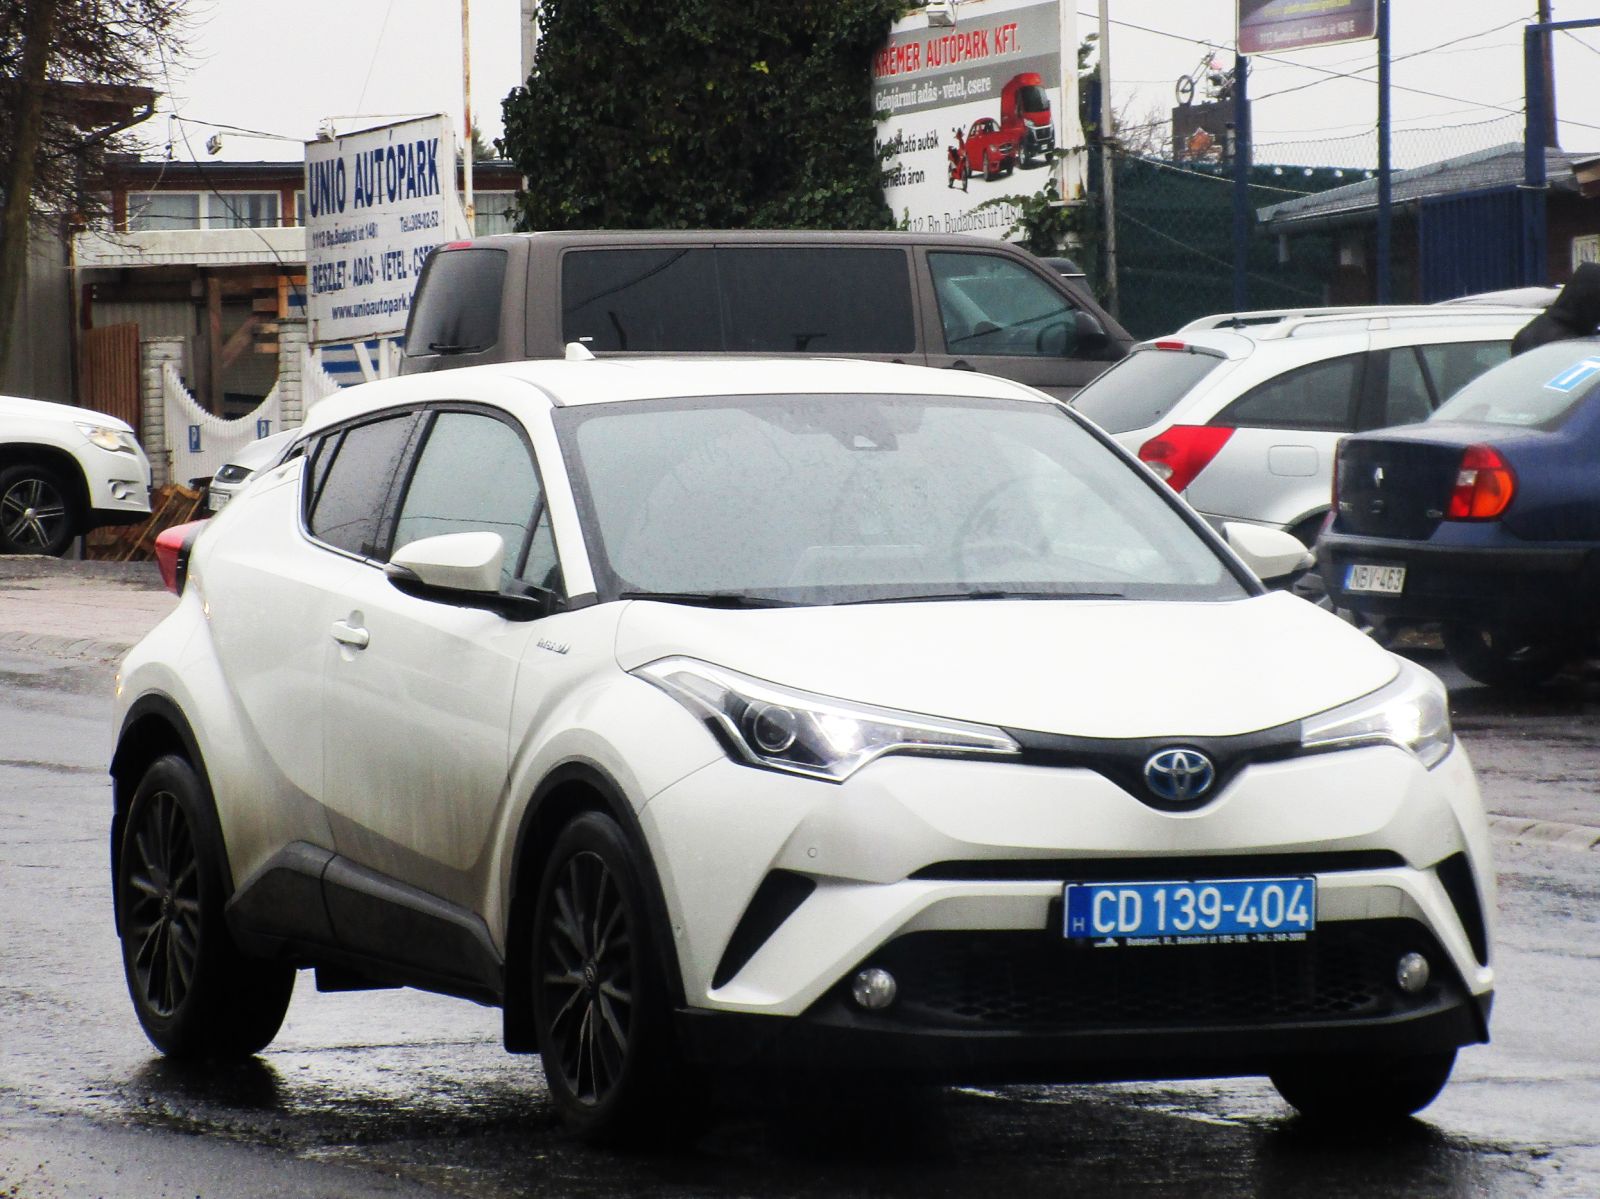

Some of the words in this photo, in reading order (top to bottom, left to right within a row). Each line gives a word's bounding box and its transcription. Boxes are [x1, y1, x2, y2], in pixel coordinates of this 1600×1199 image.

[875, 37, 920, 80] KRÉMER
[926, 29, 990, 67] AUTÓPARK
[995, 23, 1022, 56] KFT.
[875, 85, 917, 114] Gépjármű
[918, 84, 938, 104] adás
[968, 77, 991, 95] csere
[918, 129, 939, 151] autók
[309, 140, 347, 218] UNIÓ
[354, 129, 440, 210] AUTÓPARK
[908, 166, 925, 186] áron
[312, 255, 347, 294] RÉSZLET
[353, 249, 374, 288] ADÁS
[381, 244, 407, 281] VÉTEL
[413, 245, 434, 276] CSE
[332, 291, 413, 320] www.unioautopark.h
[1072, 917, 1085, 933] H
[1092, 889, 1143, 934] CD
[1153, 884, 1309, 932] 139-404
